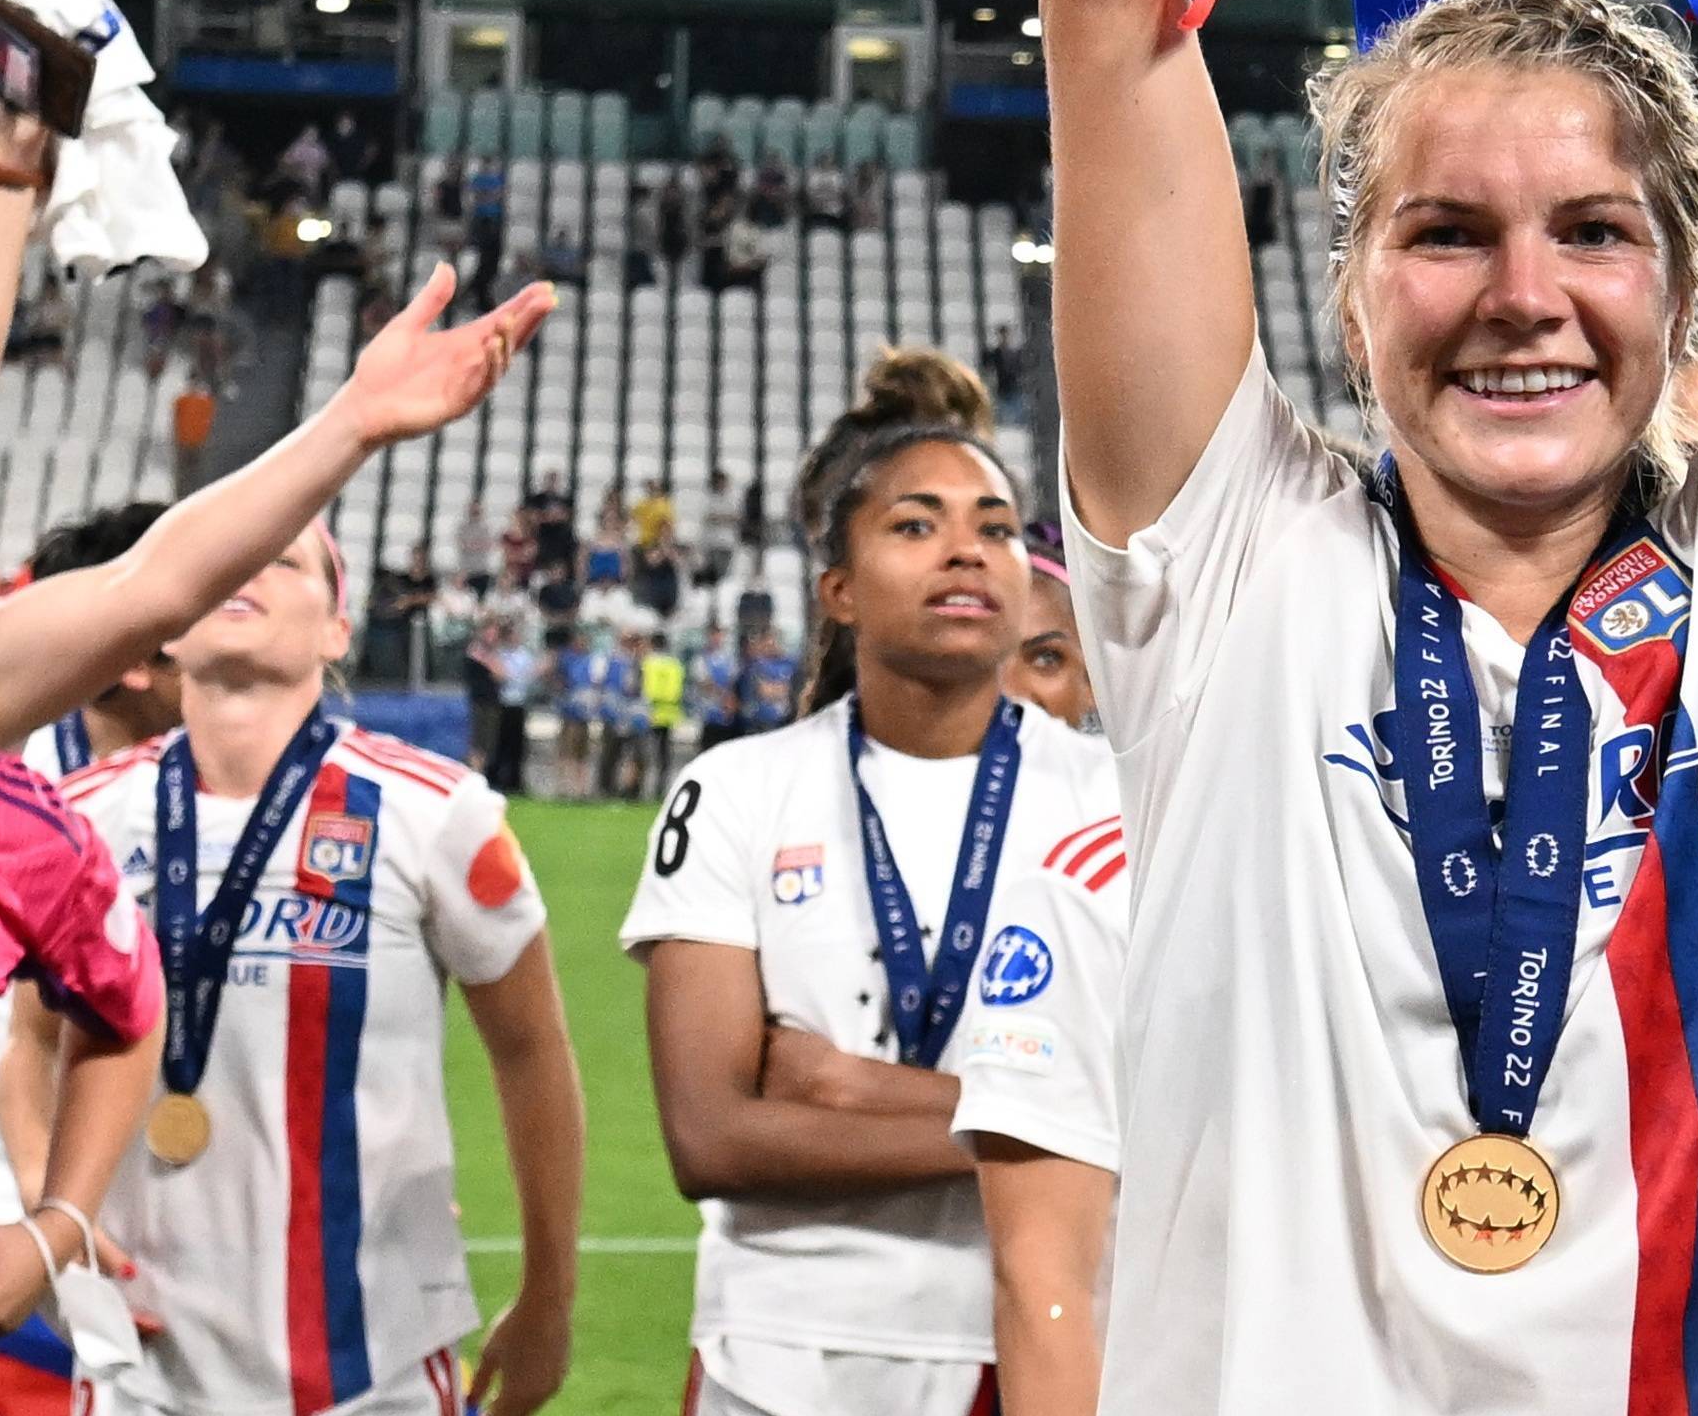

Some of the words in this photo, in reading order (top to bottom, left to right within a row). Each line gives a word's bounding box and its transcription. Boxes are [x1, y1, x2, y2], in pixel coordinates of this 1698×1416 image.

[1572, 548, 1649, 612] OLYMPIQUE
[1577, 557, 1659, 619] LYONNAIS
[1421, 565, 1444, 665] FINA
[1548, 636, 1574, 662] 22
[1419, 677, 1449, 701] 22
[1537, 675, 1565, 778] FINAL
[653, 778, 702, 879] 8
[1503, 1052, 1533, 1088] 22
